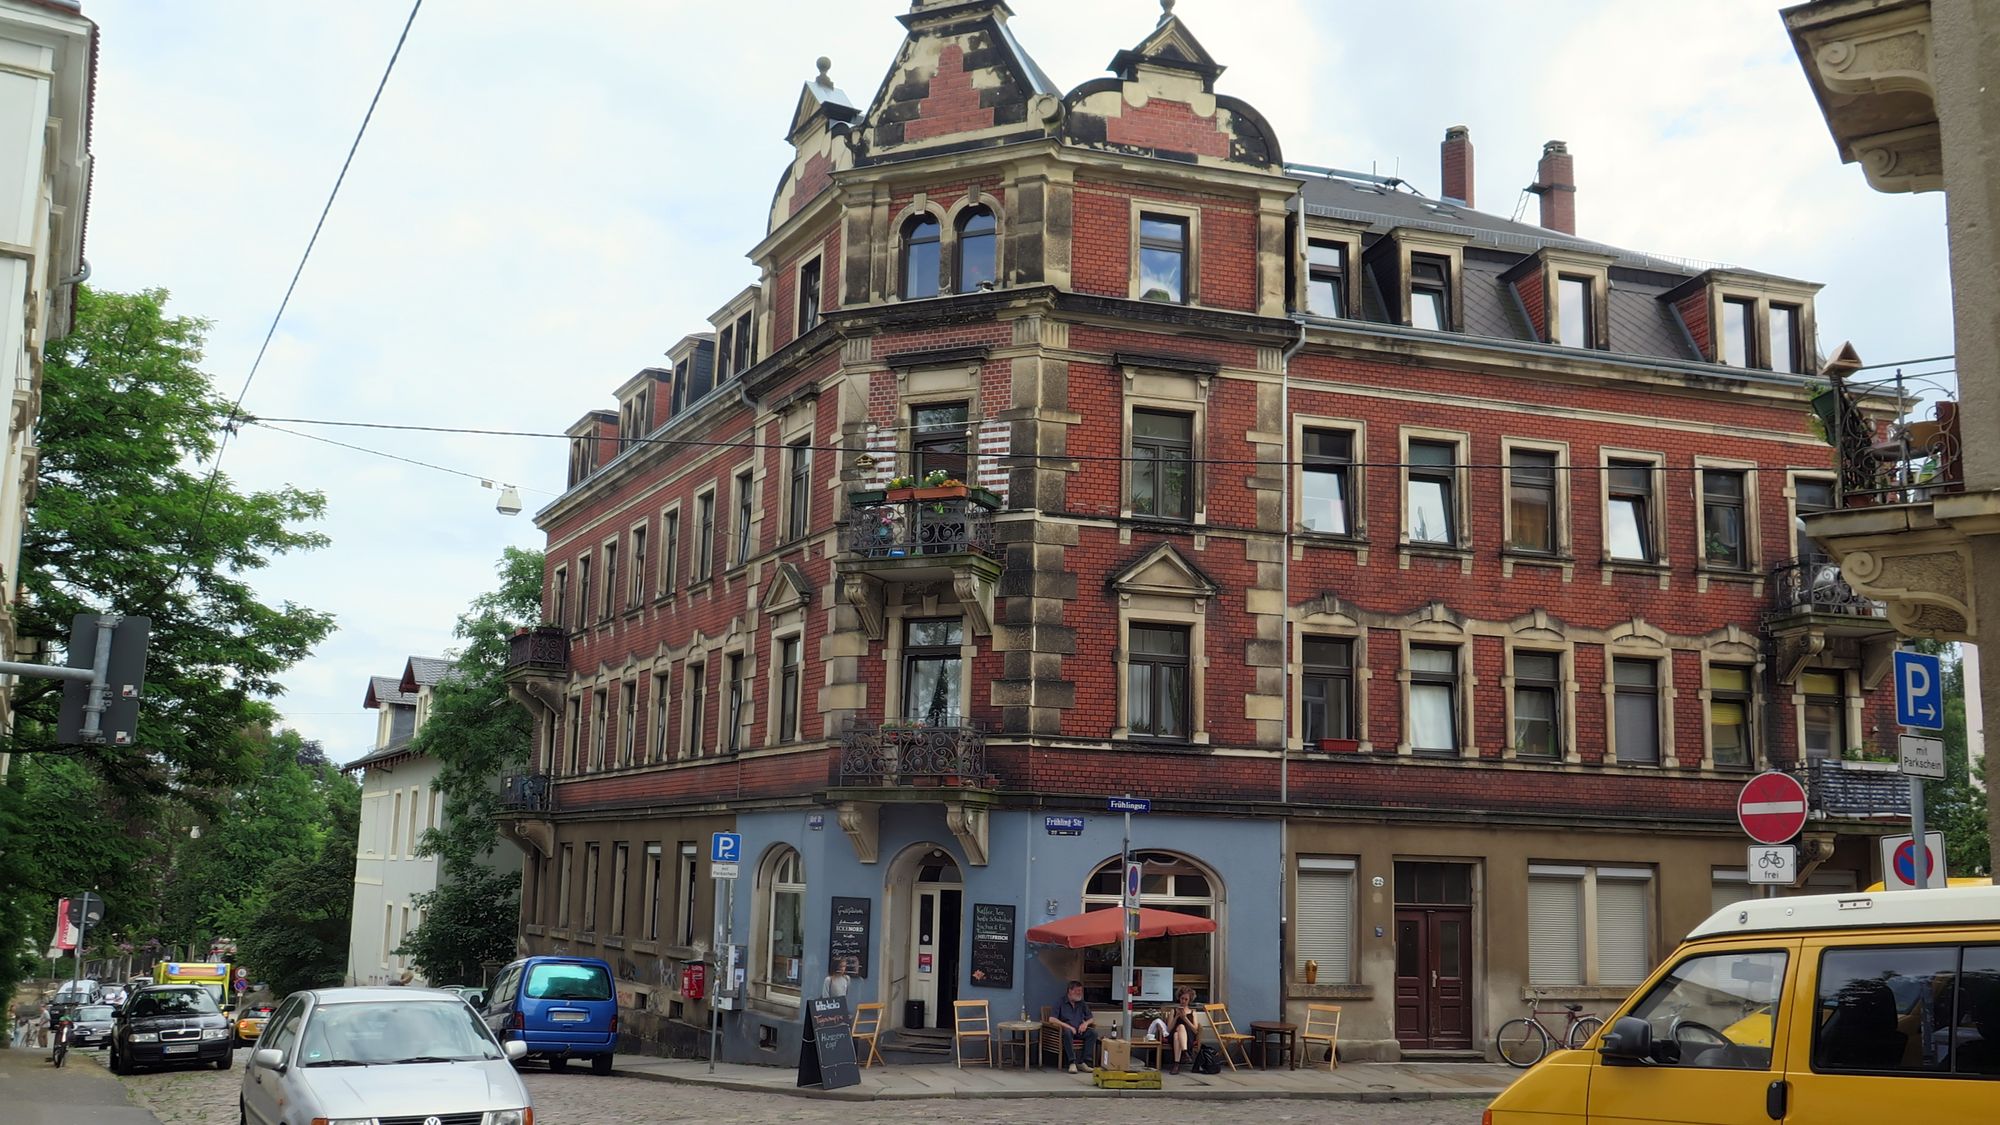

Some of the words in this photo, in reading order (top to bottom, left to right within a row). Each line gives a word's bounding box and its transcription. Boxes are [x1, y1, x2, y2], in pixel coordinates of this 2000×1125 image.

[1915, 746, 1928, 756] mit
[1903, 756, 1942, 771] Parkschein
[1110, 800, 1147, 811] Frühlingstr.
[1764, 870, 1779, 879] frei
